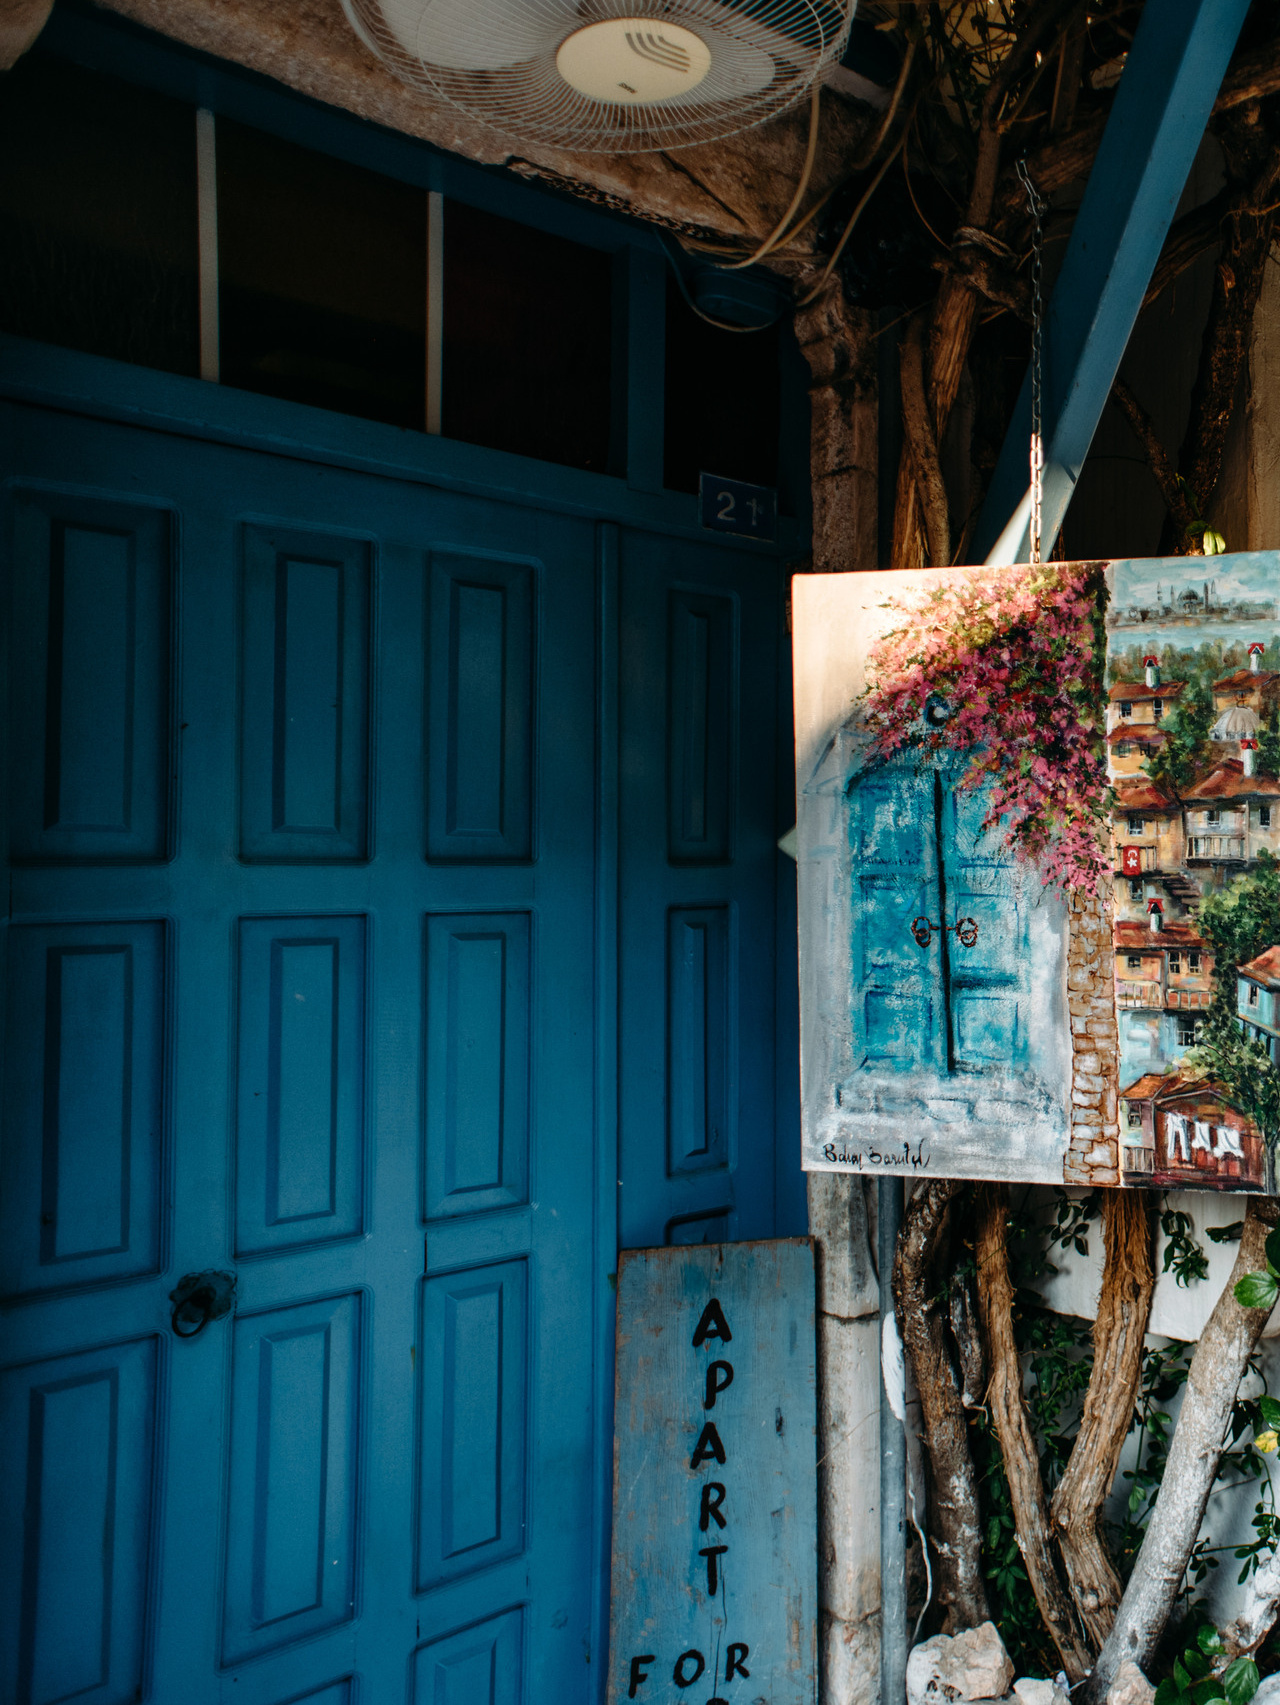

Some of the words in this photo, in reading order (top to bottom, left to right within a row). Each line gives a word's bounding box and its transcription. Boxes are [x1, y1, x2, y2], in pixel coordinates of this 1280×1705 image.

[717, 491, 758, 526] 21
[692, 1298, 734, 1597] APART
[628, 1642, 750, 1699] FOR
